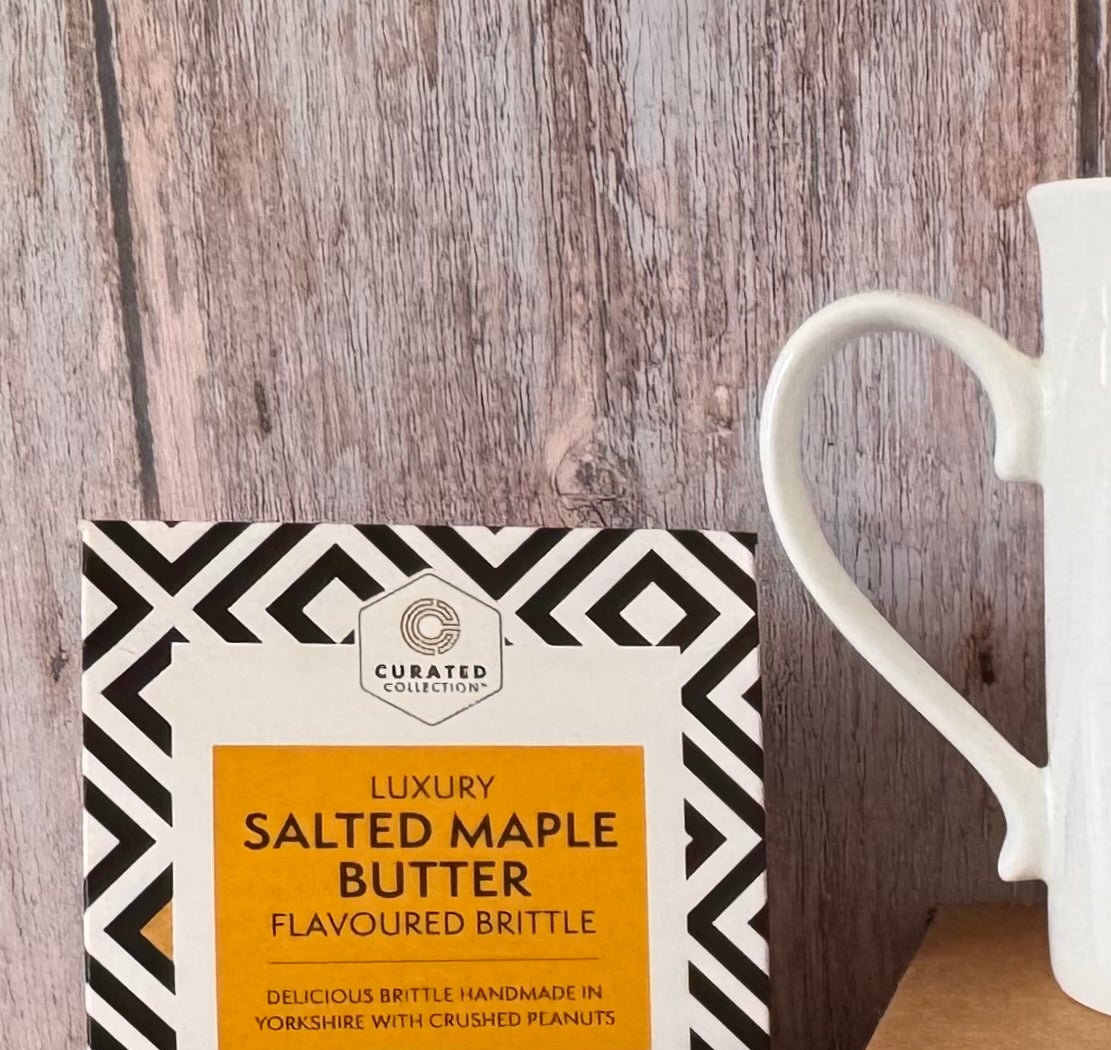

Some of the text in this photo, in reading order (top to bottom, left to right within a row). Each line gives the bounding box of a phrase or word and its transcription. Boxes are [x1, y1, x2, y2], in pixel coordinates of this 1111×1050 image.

[374, 664, 487, 679] CURATED
[371, 775, 495, 799] LUXURY
[244, 811, 618, 850] SALTED MAPLE
[339, 860, 532, 899] BUTTER
[271, 909, 597, 937] FLAVOURED BRITTLE
[266, 984, 602, 1005] DELICIOUS BRITTLE HANDMADE IN
[255, 1010, 616, 1031] YORKSHIRE WITH CRUSHED PEANUTS
